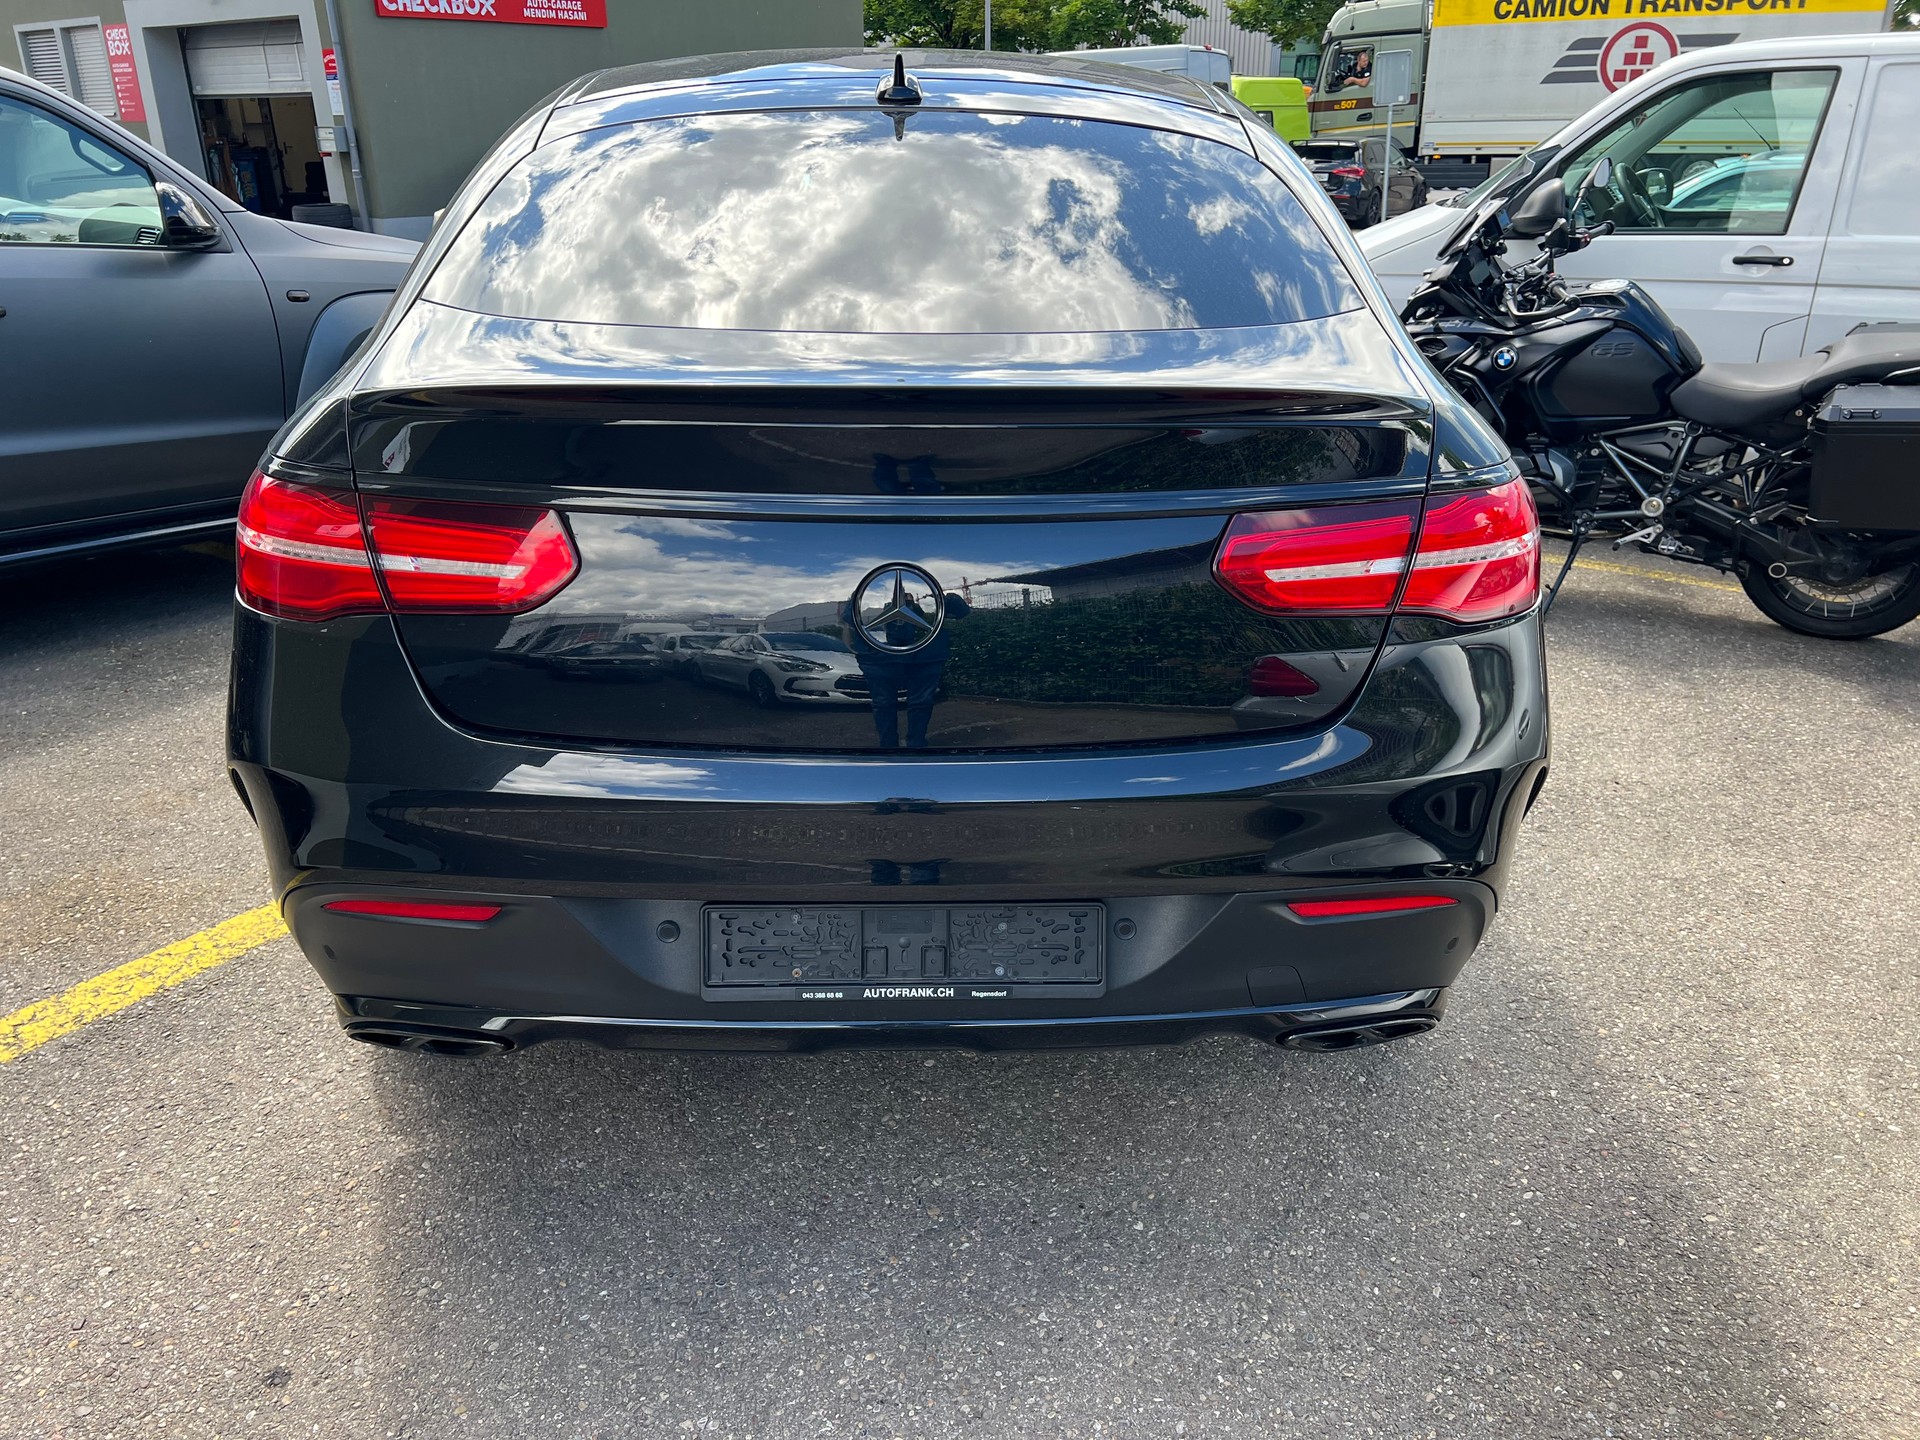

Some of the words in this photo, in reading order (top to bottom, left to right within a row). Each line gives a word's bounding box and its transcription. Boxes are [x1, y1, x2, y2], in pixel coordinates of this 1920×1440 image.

[527, 0, 582, 10] AUTO-GARAGE
[1493, 0, 1610, 20] CAMION
[523, 8, 556, 19] MENDIM
[557, 10, 587, 21] HASANI
[106, 28, 128, 40] CHECK
[108, 40, 131, 56] BOX
[1340, 100, 1357, 109] 507
[863, 988, 954, 998] AUTOFRANK.CH
